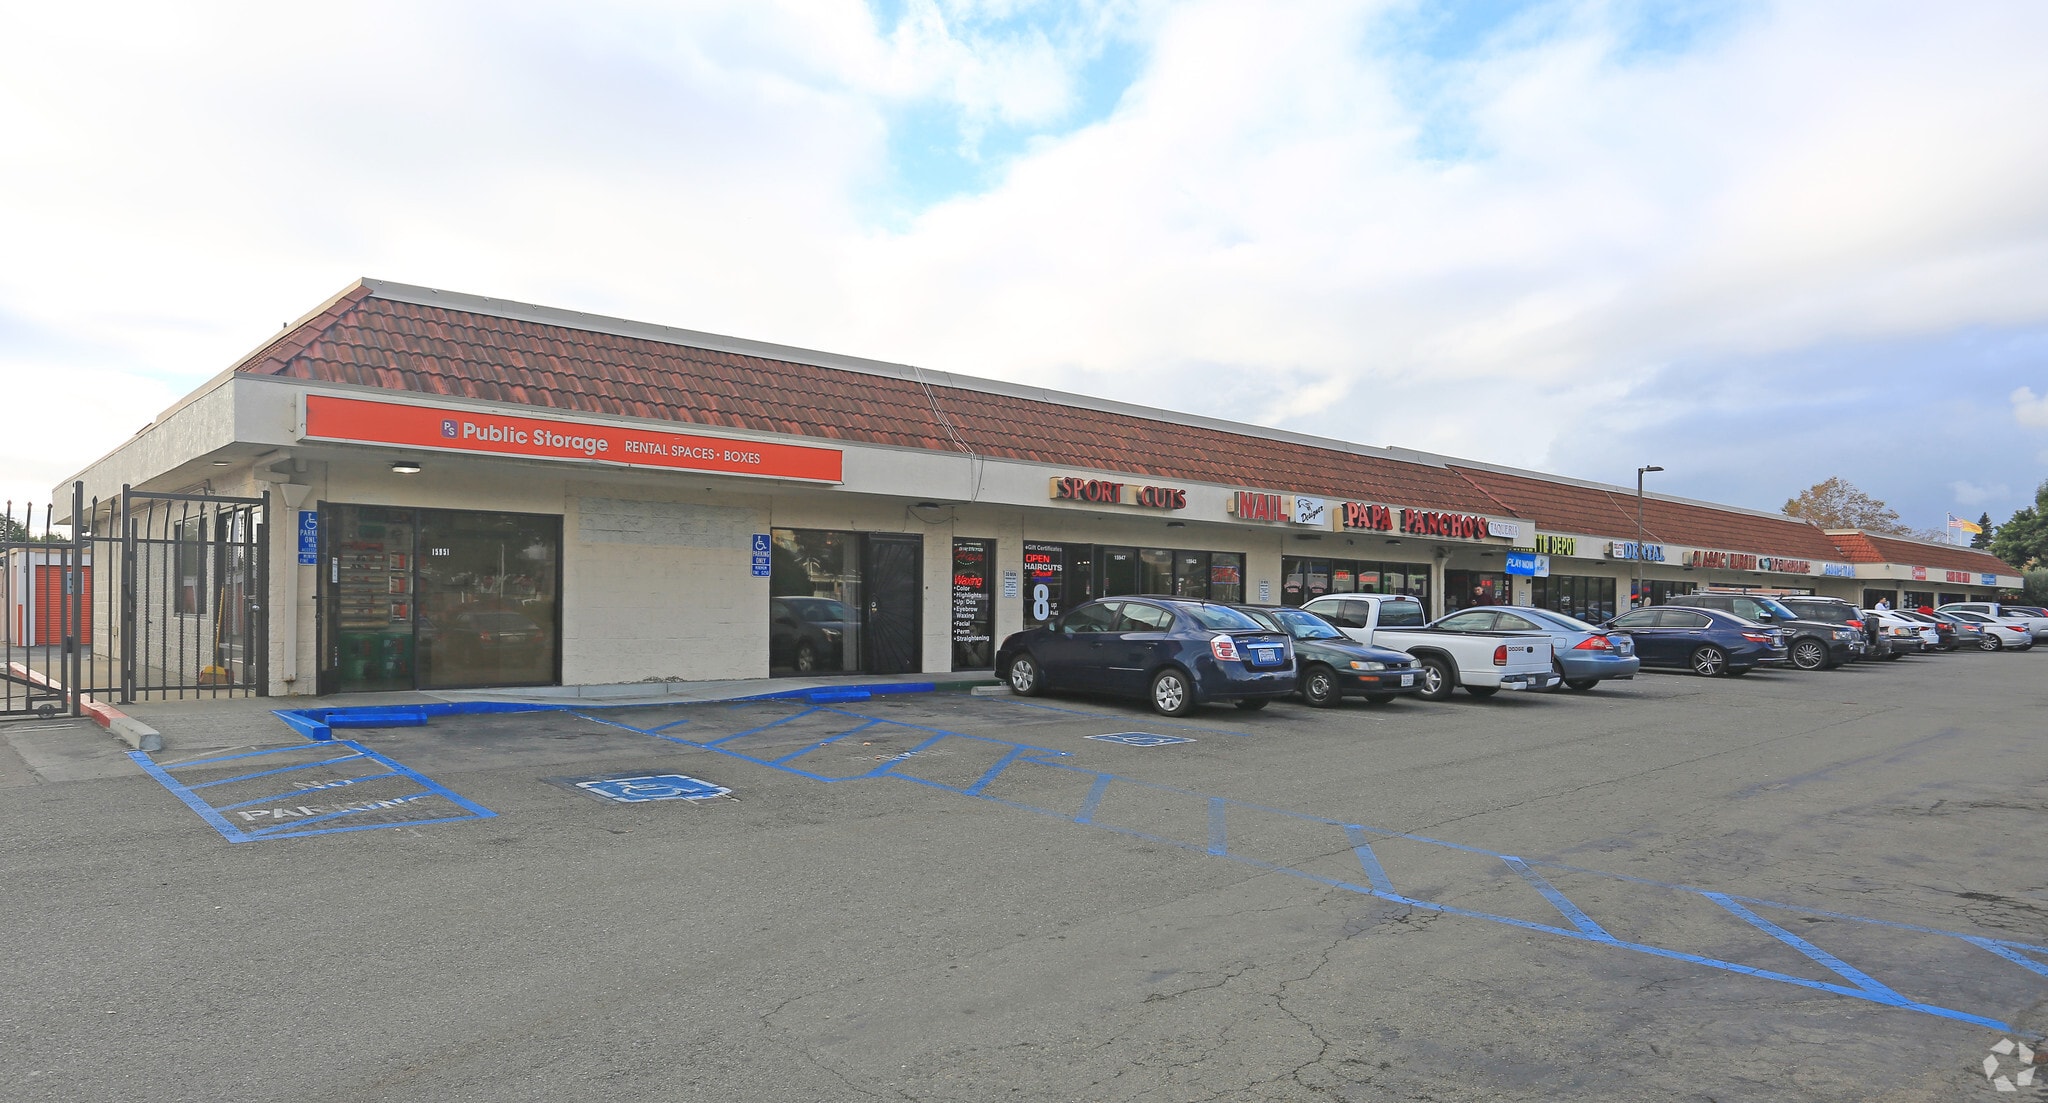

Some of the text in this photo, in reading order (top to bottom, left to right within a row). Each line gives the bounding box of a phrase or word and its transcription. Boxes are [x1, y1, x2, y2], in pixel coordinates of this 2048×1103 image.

[463, 422, 608, 456] Public Storage
[625, 440, 761, 464] RENTAL SPACES BOXES
[1059, 476, 1187, 509] SPORT CUTS
[1238, 491, 1288, 522] NAIL
[1301, 505, 1324, 523] Designer
[1344, 501, 1487, 539] PAPA PANCHO'S
[1490, 522, 1519, 537] TAQUERIA
[1551, 536, 1577, 556] DEPOT
[1024, 563, 1063, 572] HAIRCUTS
[1025, 553, 1051, 563] OPEN
[954, 574, 984, 589] Waxing
[1033, 583, 1050, 621] 8
